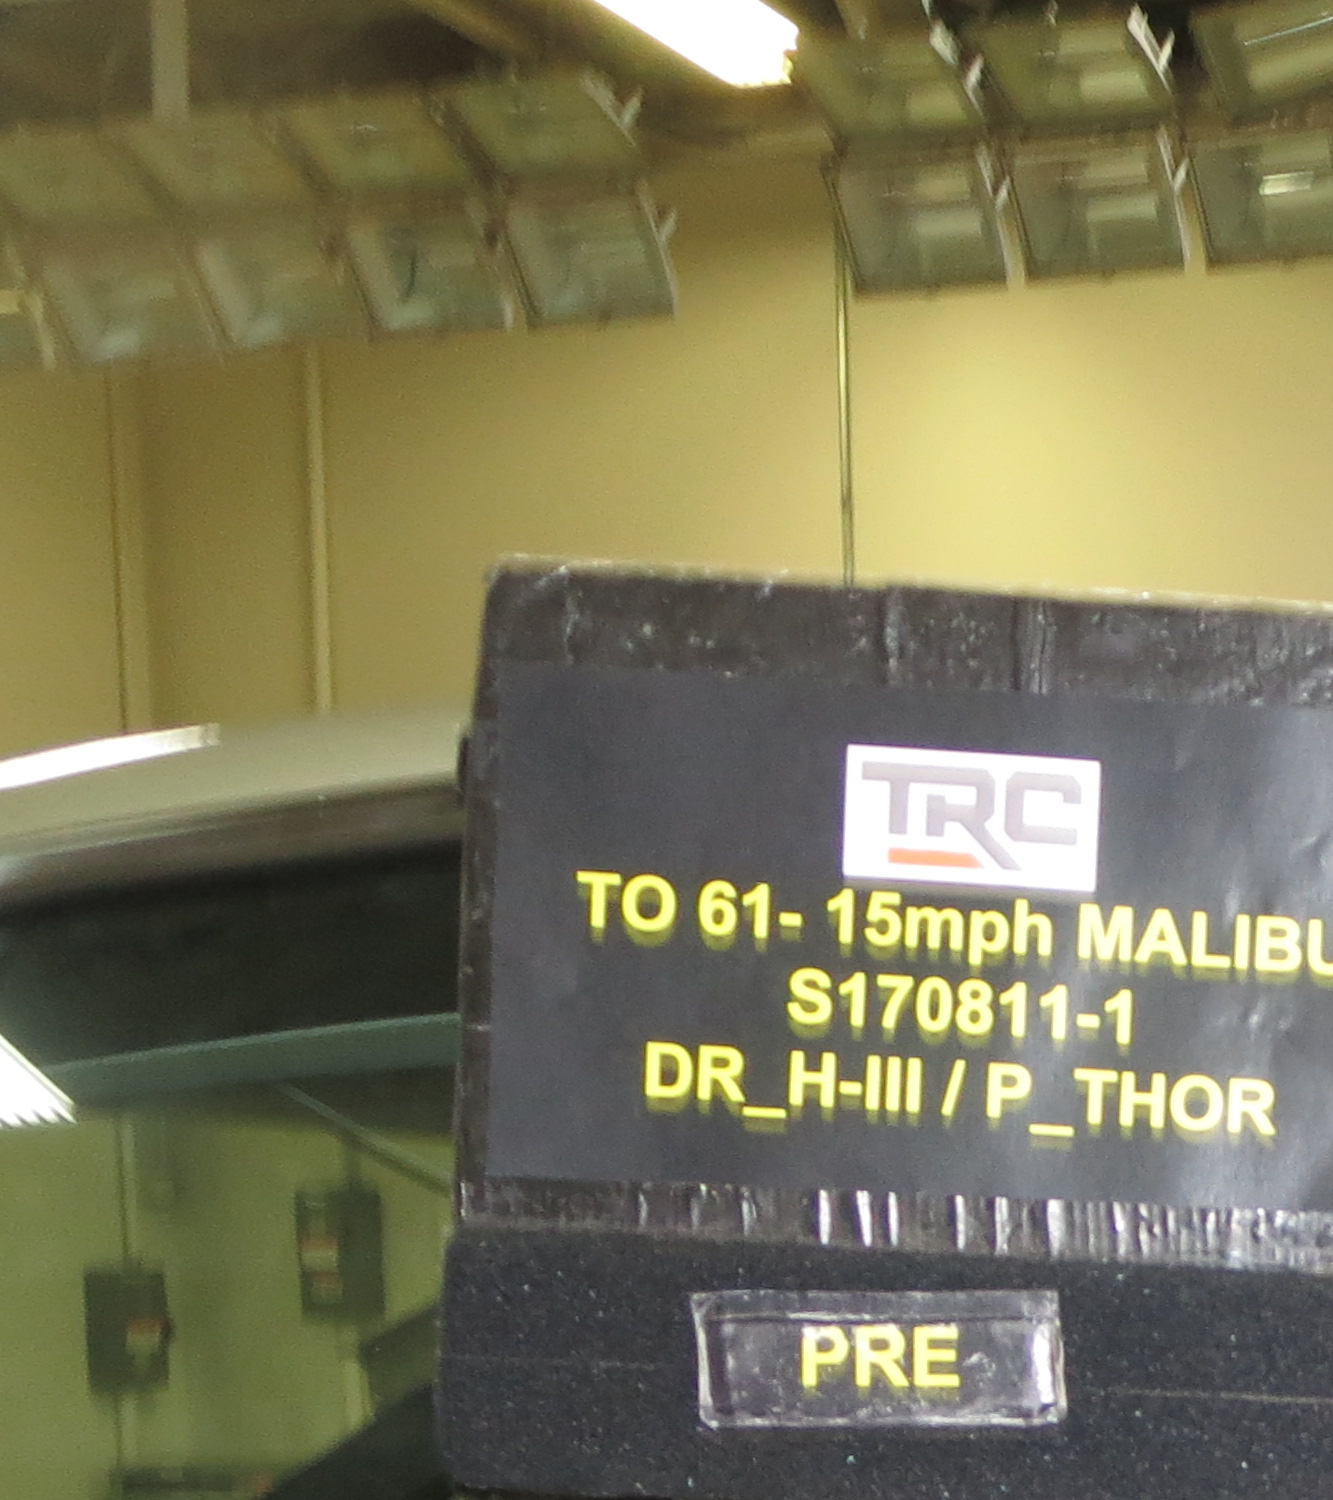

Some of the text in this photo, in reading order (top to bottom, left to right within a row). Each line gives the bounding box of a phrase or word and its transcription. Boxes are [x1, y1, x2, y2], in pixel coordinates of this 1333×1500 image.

[861, 759, 1083, 871] TRC
[576, 870, 678, 942] TO
[697, 879, 804, 949] 61-
[826, 888, 1052, 971] 15mph
[787, 967, 1134, 1045] S170811-1
[645, 1040, 1276, 1138] DR_H-III / P_THOR
[800, 1325, 961, 1391] PRE
